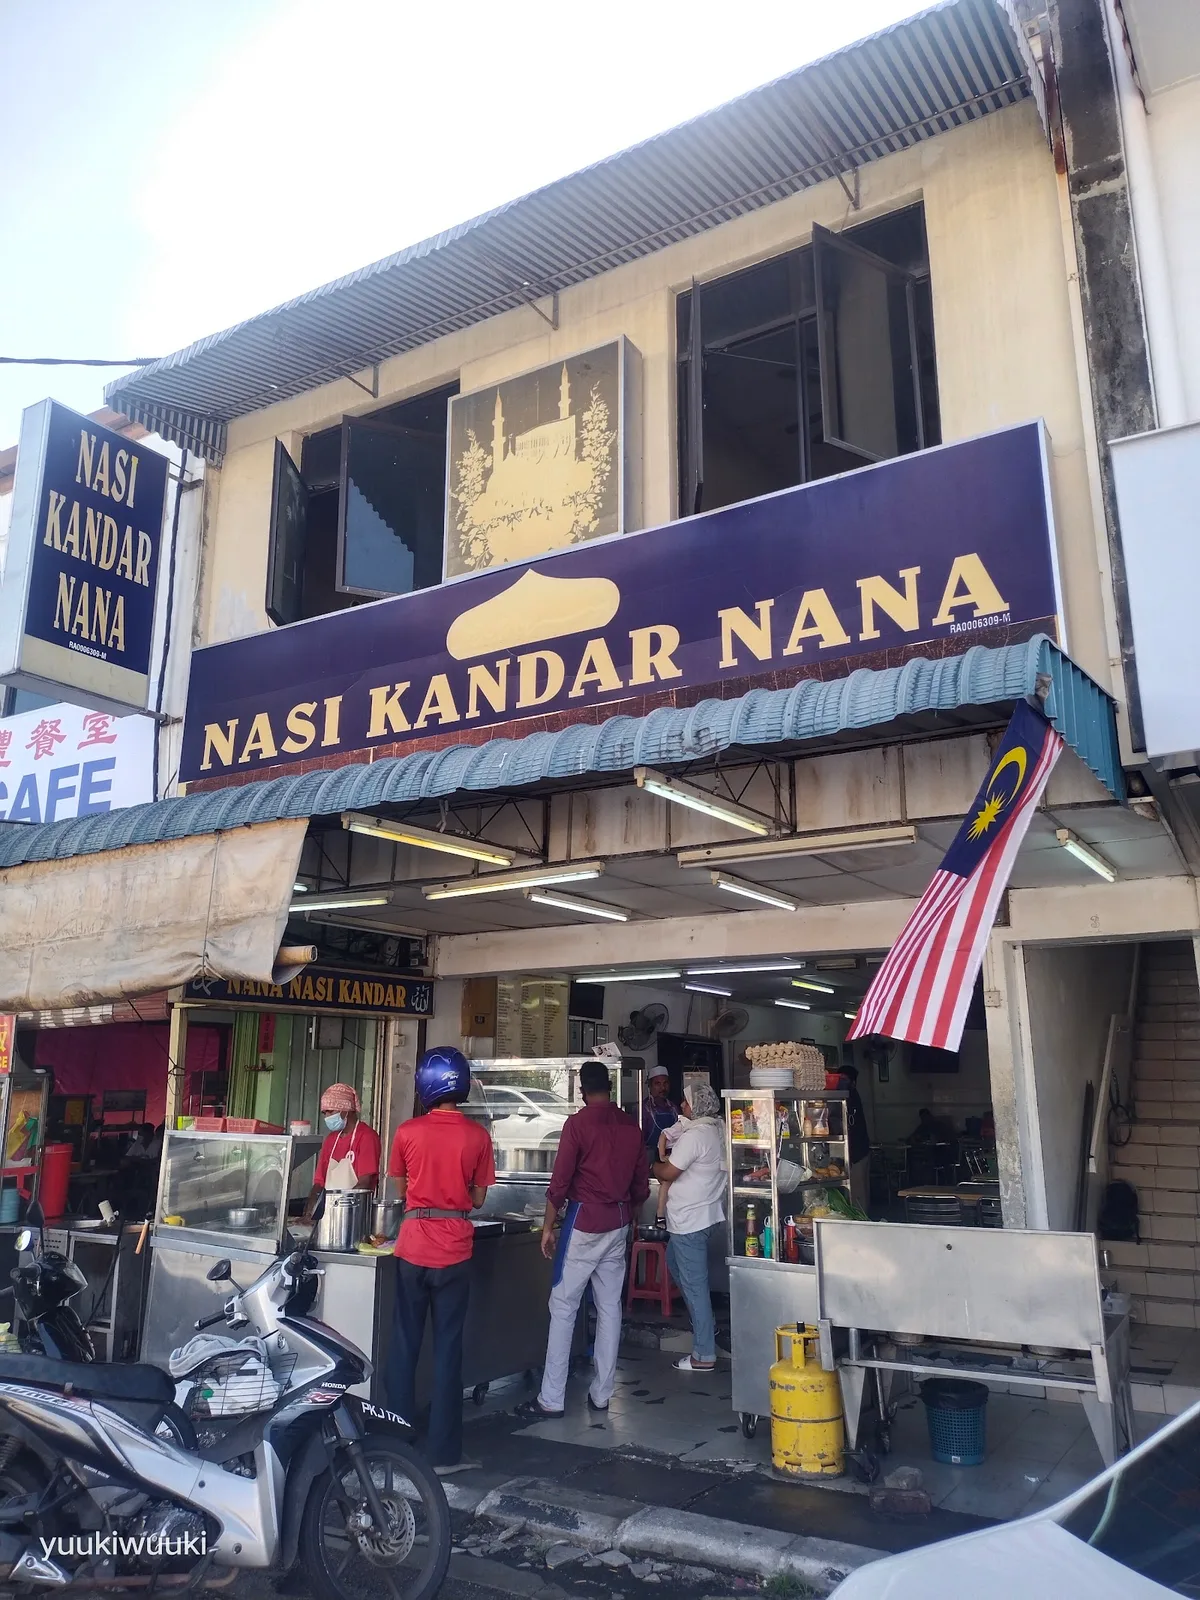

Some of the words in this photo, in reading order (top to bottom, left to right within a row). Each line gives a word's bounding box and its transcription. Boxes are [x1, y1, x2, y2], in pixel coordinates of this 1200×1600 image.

[75, 429, 139, 509] NASI
[43, 489, 152, 588] KANDAR
[53, 571, 125, 651] NANA
[949, 612, 1011, 634] RA0006309-M
[200, 695, 343, 771] NASI
[366, 624, 683, 738] KANDAR
[717, 552, 1010, 669] NANA
[226, 977, 283, 999] NANA
[289, 975, 333, 1002] NASI
[338, 979, 407, 1008] KANDAR
[321, 1381, 347, 1390] HONDA
